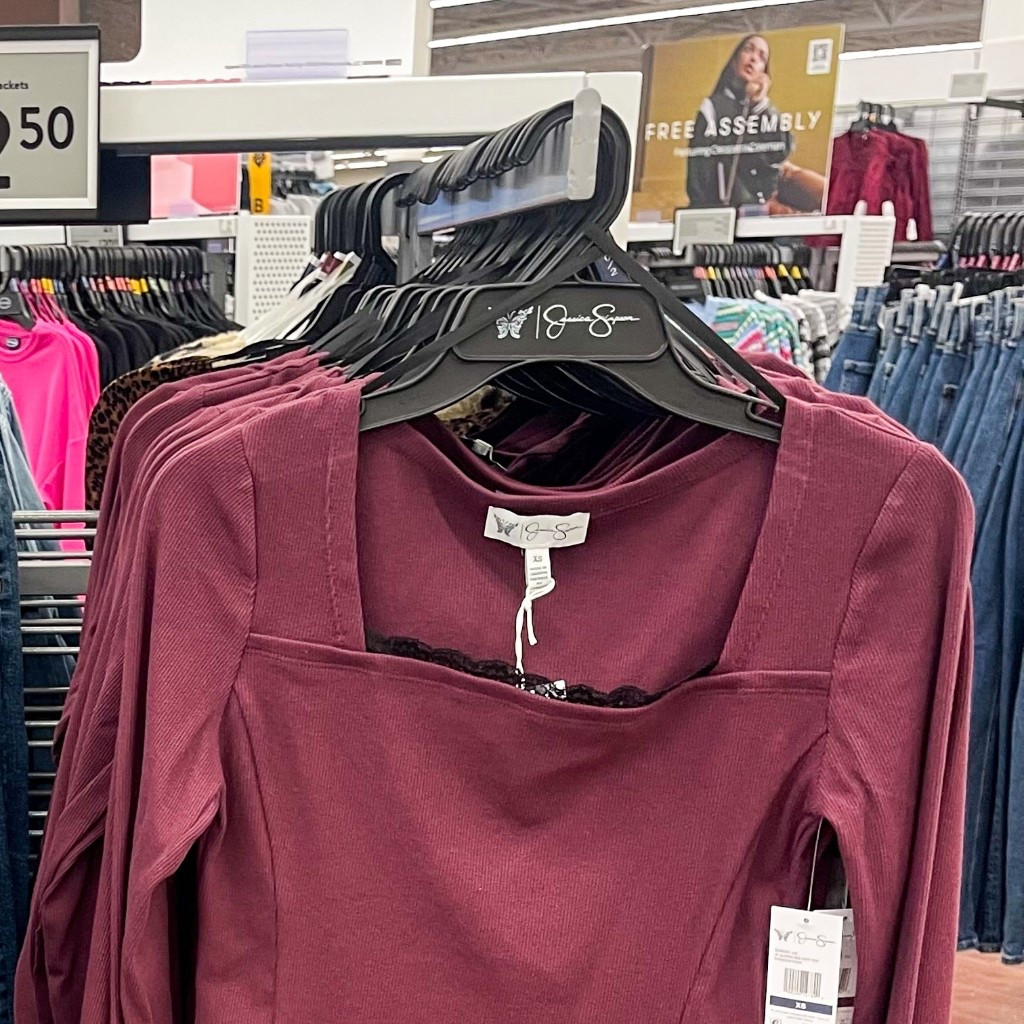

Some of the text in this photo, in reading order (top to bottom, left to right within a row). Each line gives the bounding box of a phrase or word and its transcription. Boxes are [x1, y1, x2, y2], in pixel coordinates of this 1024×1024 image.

[645, 110, 822, 141] FREE ASSEMBLY
[794, 1001, 807, 1010] XS
